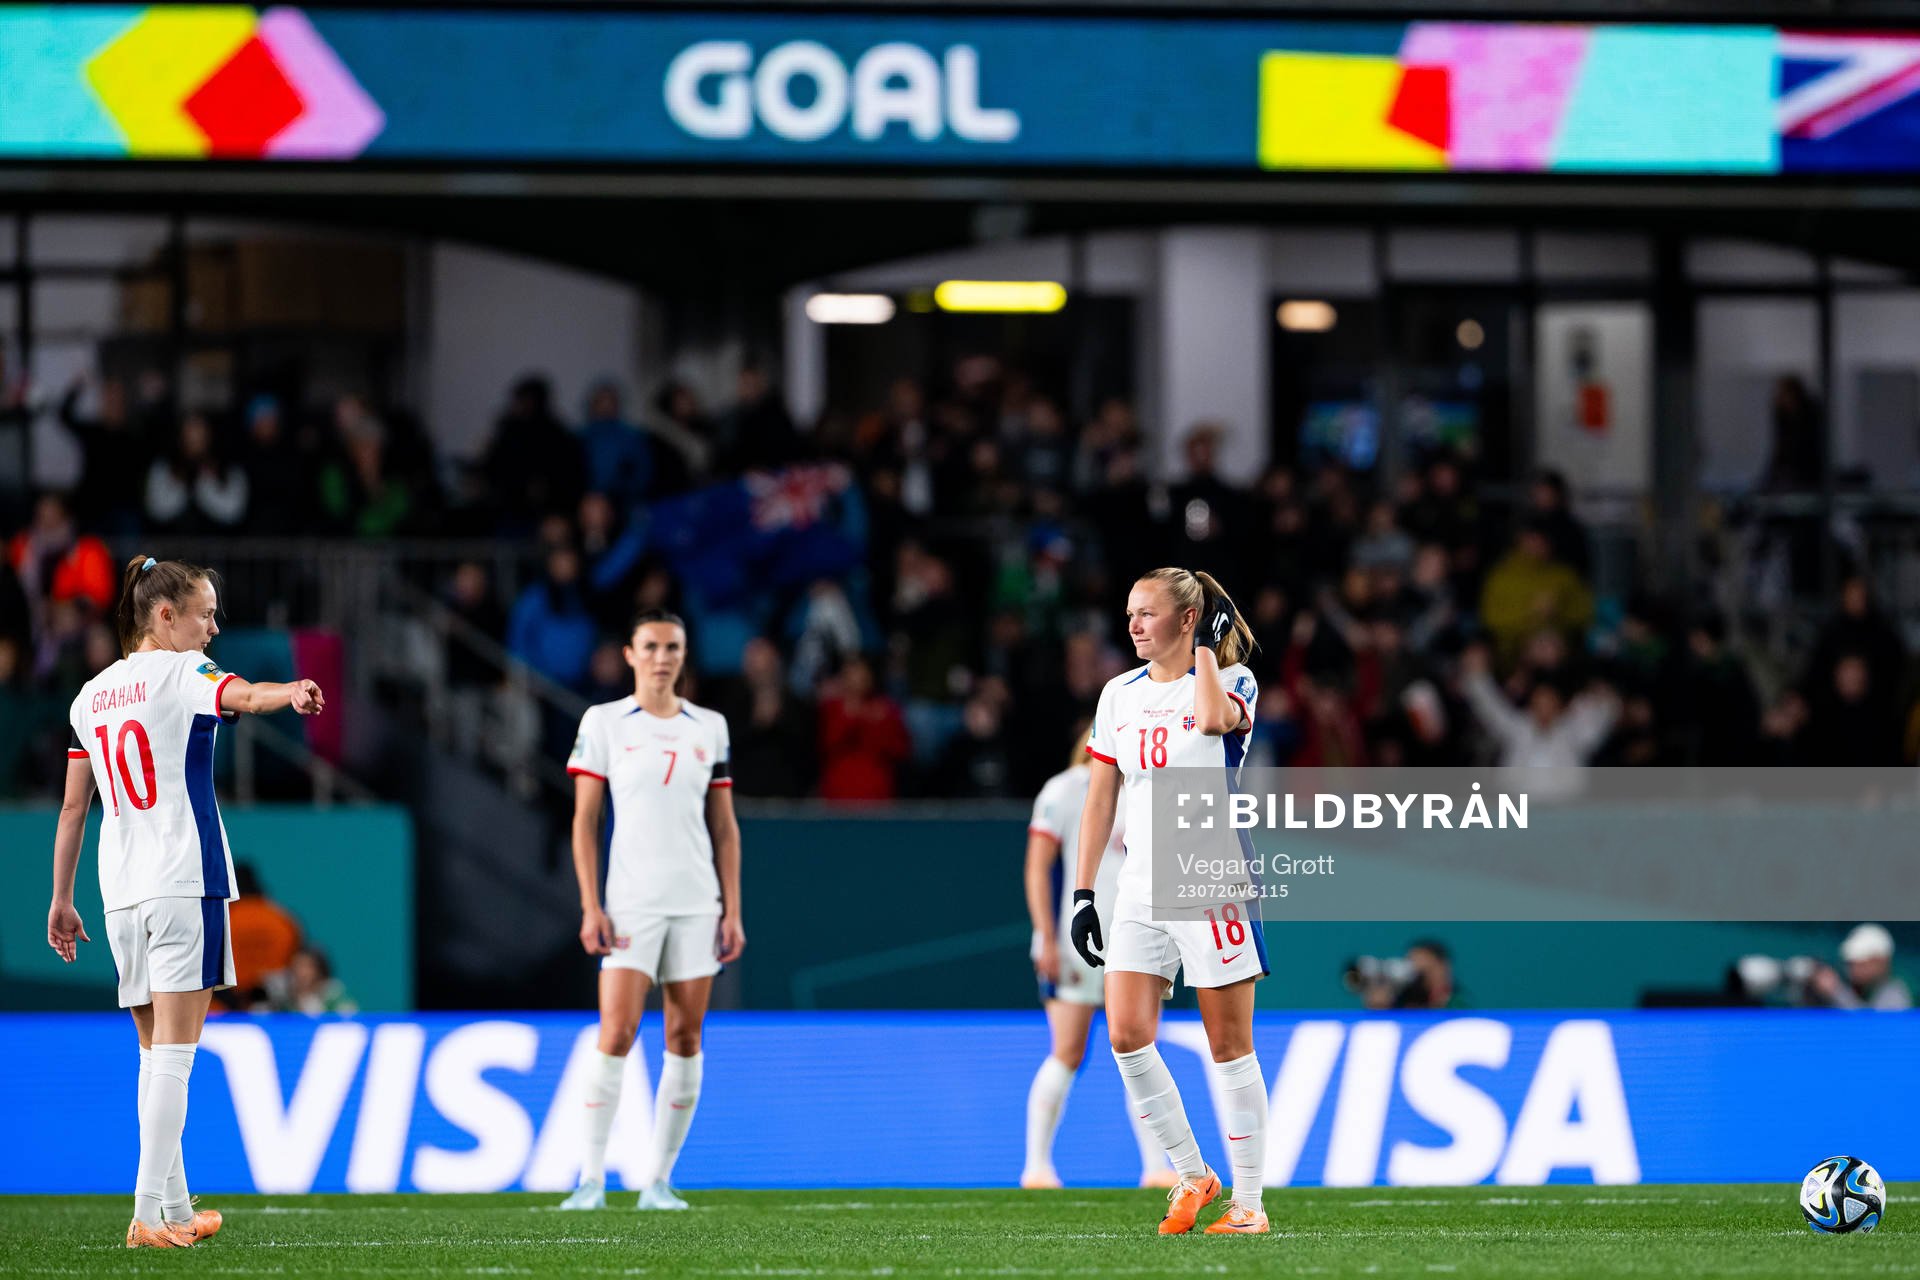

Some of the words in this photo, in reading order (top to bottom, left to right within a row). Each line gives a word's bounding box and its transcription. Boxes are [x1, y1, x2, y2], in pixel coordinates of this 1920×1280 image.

[663, 40, 1021, 142] GOAL
[92, 681, 146, 713] GRAHAM
[95, 719, 157, 816] 10
[663, 750, 677, 785] 7
[1139, 727, 1169, 770] 18
[1203, 902, 1246, 951] 18
[198, 1020, 658, 1194] VISA
[1158, 1017, 1642, 1187] VISA
